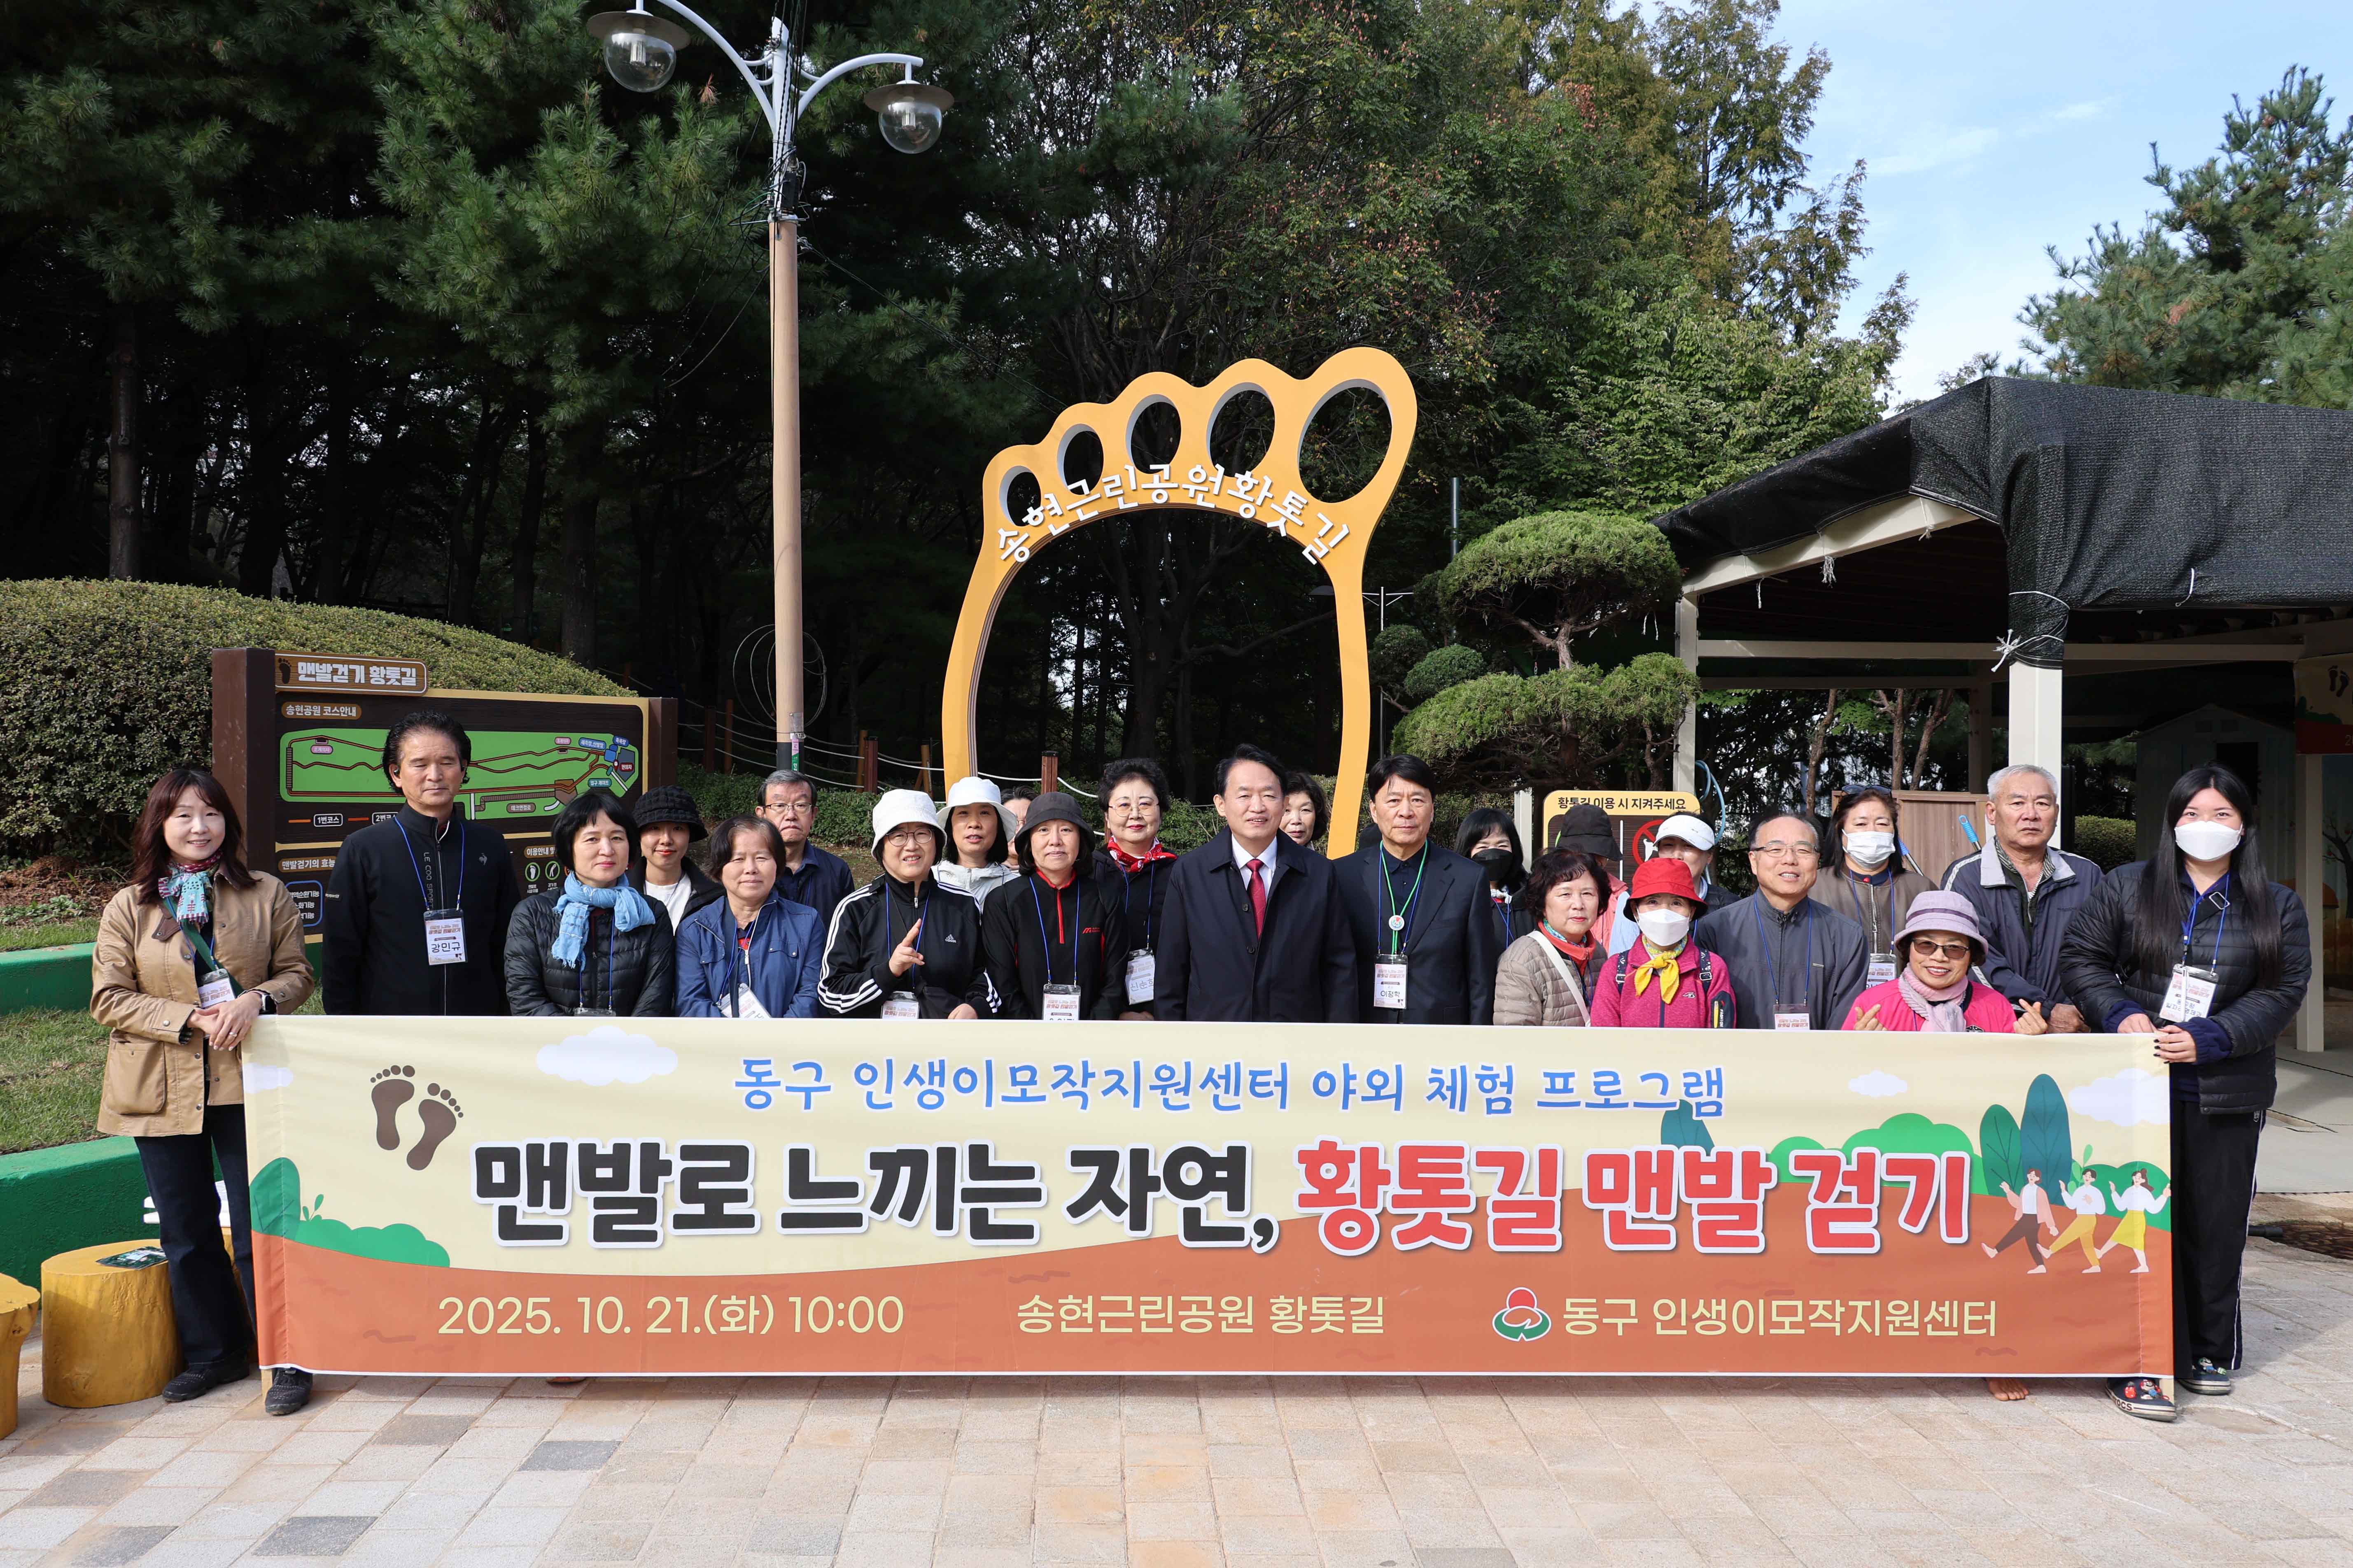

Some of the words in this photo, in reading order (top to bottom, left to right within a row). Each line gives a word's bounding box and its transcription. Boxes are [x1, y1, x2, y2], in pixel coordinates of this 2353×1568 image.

[297, 662, 365, 683] 맨발걷기
[369, 665, 416, 686] 황톳길
[286, 704, 321, 716] 송현공원
[322, 706, 357, 717] 코스안내
[1593, 797, 1615, 809] 이용
[1618, 798, 1628, 810] 시
[1631, 798, 1686, 810] 지켜주세요
[424, 852, 431, 862] LE
[527, 847, 549, 856] 이용안내
[282, 859, 319, 870] 맨발걷기의
[321, 858, 336, 867] 효능
[431, 942, 461, 953] 강민규
[735, 1059, 831, 1110] 동구
[854, 1059, 1288, 1111] 인생이모작지원센터
[1312, 1062, 1403, 1111] 야외
[1426, 1064, 1514, 1114] 체험
[1537, 1067, 1724, 1117] 프로그램
[475, 1142, 756, 1243] 맨발로
[781, 1144, 1042, 1240] 느끼는
[1066, 1146, 1274, 1248] 자연,
[1298, 1140, 1567, 1250] 황톳길
[1586, 1149, 1772, 1248] 맨발
[1794, 1151, 1966, 1249] 걷기
[438, 1296, 561, 1335] 2025.
[577, 1296, 631, 1334] 10.
[646, 1294, 774, 1335] 21.(화)
[788, 1295, 904, 1334] 10:00
[1017, 1294, 1254, 1333] 송현근린공원
[1269, 1295, 1384, 1334] 황톳길
[1563, 1298, 1639, 1336] 동구
[1653, 1298, 1996, 1337] 인생이모작지원센터
